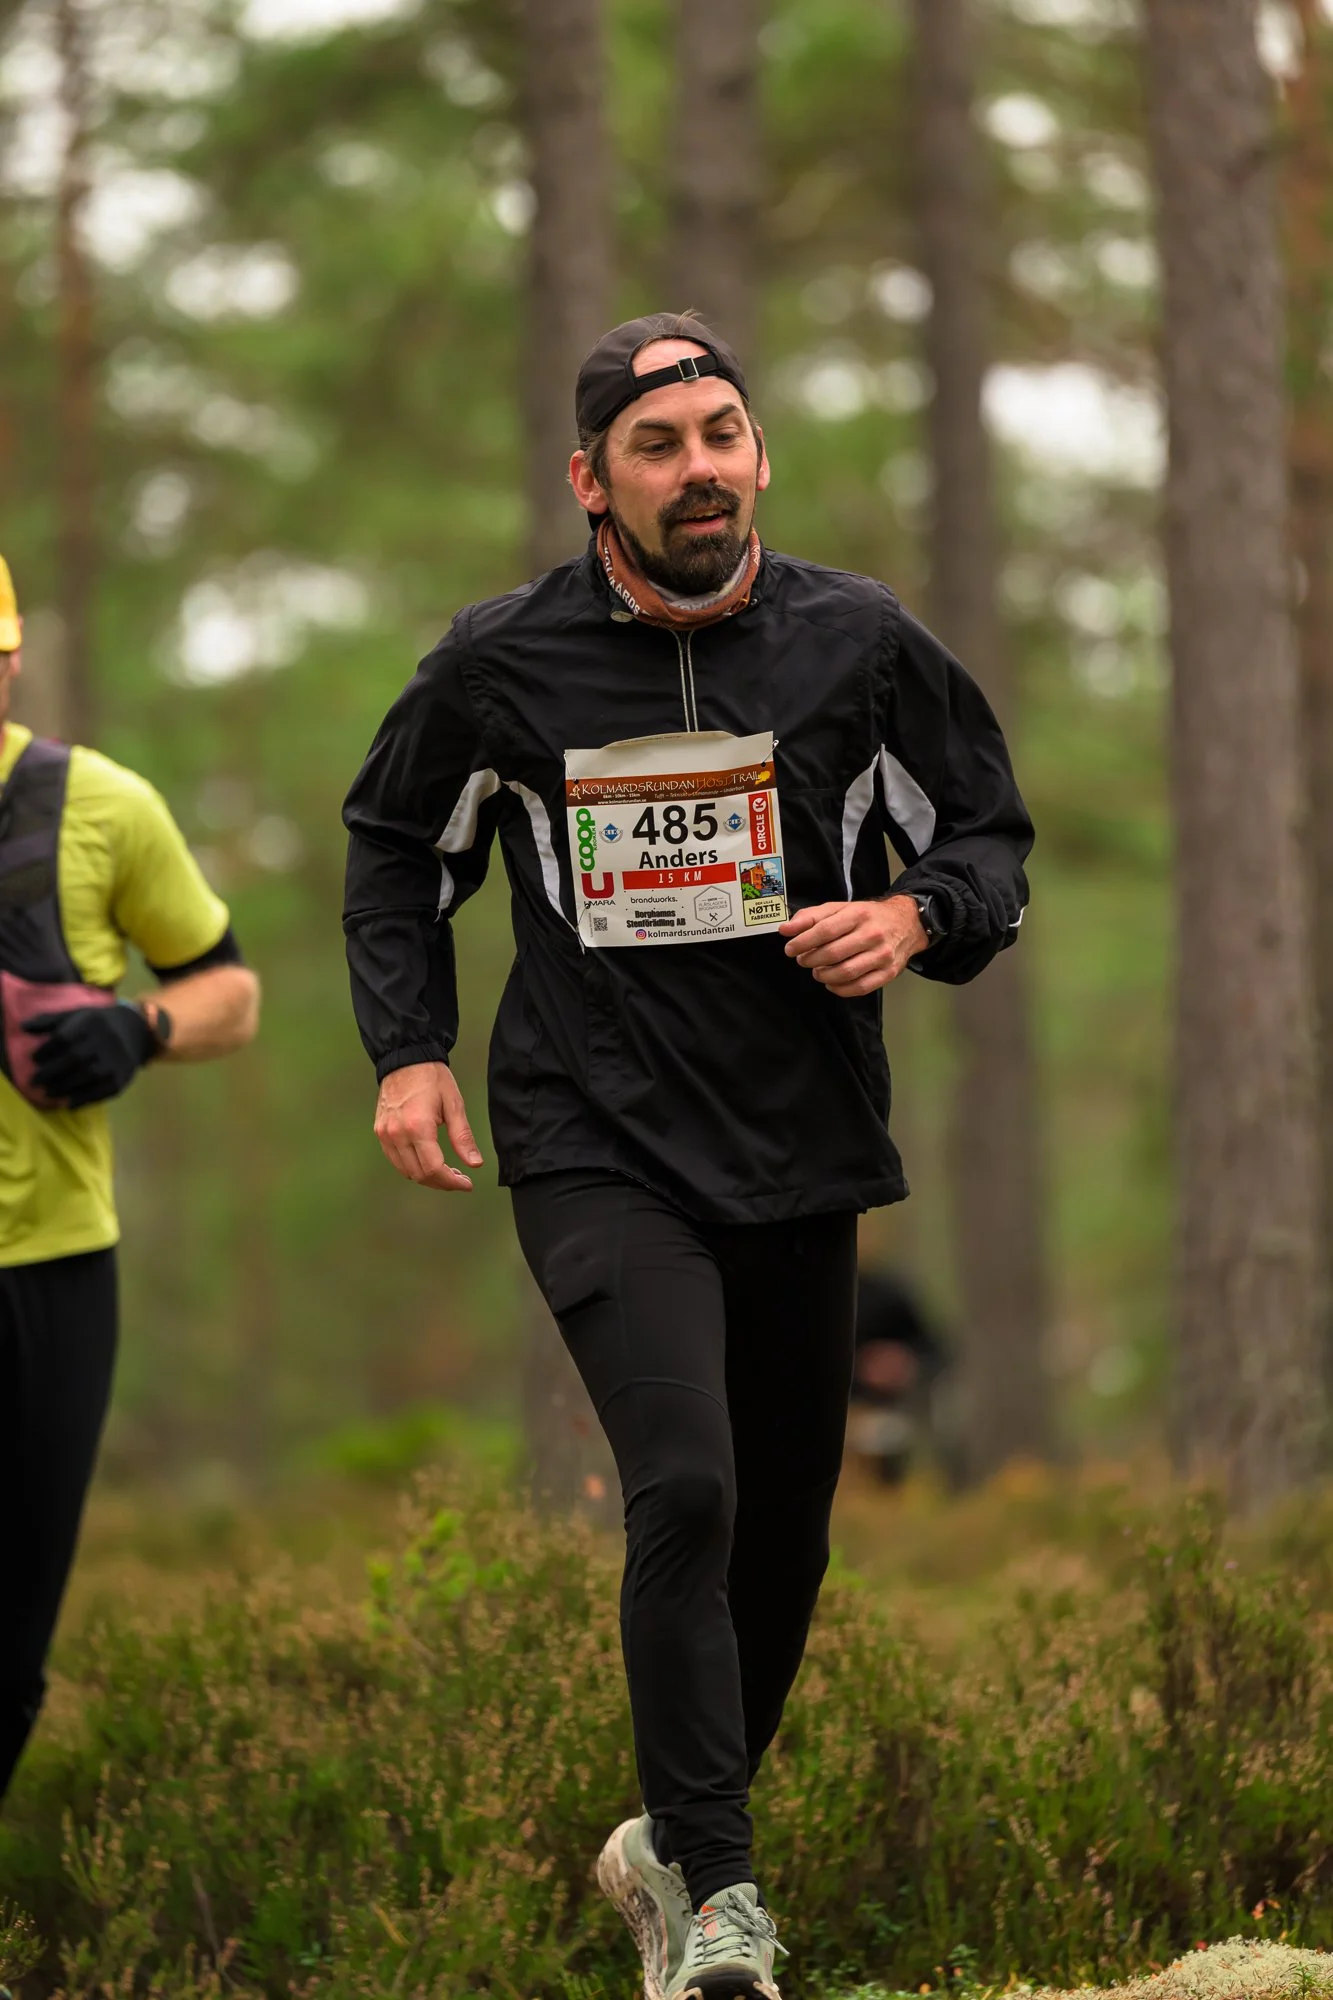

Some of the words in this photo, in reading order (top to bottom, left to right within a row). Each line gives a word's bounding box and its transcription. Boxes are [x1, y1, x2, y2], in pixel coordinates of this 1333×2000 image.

[731, 771, 760, 784] TRAIL
[632, 802, 718, 846] 485
[576, 808, 596, 871] coop
[756, 814, 767, 851] CIRCLE
[639, 849, 718, 870] Anders
[749, 903, 781, 915] NØTTE
[677, 918, 686, 926] AB
[751, 913, 780, 921] FABRIKKEN
[648, 924, 735, 938] kolmardsrundantrail
